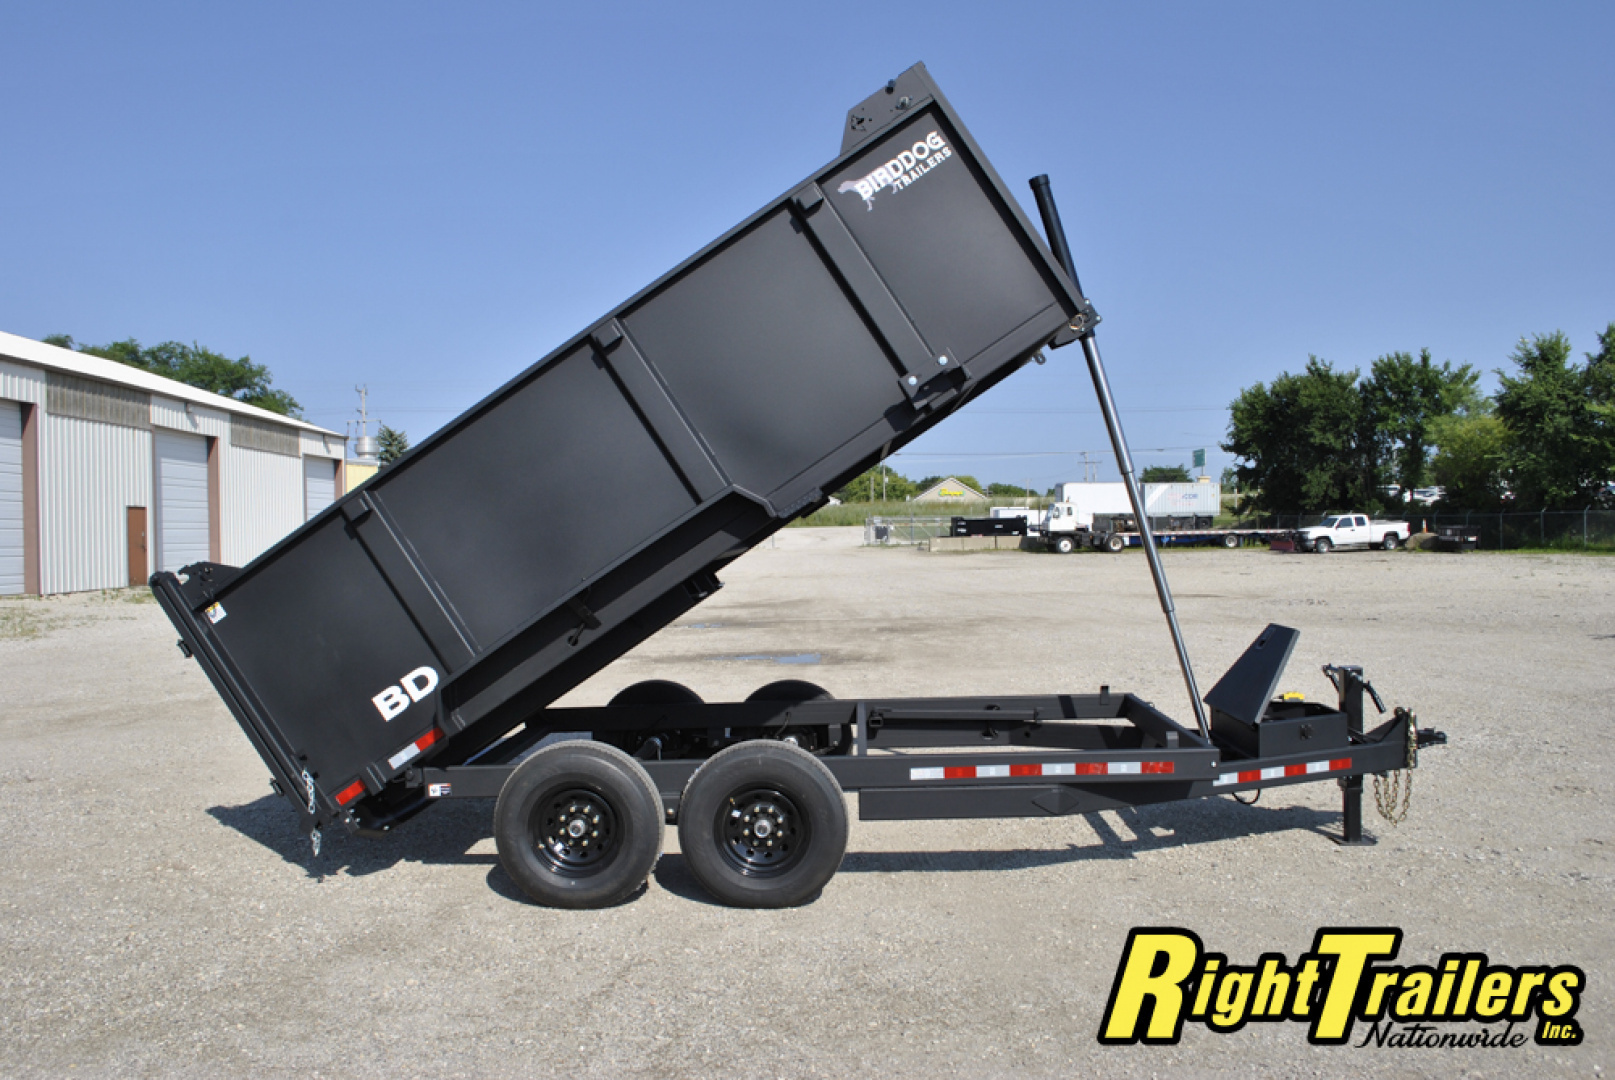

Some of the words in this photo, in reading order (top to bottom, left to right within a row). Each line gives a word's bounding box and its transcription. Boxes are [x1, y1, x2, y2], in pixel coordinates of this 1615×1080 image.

[855, 130, 946, 200] BIRDDOG
[894, 146, 952, 190] TRAILERS
[371, 666, 439, 722] BD
